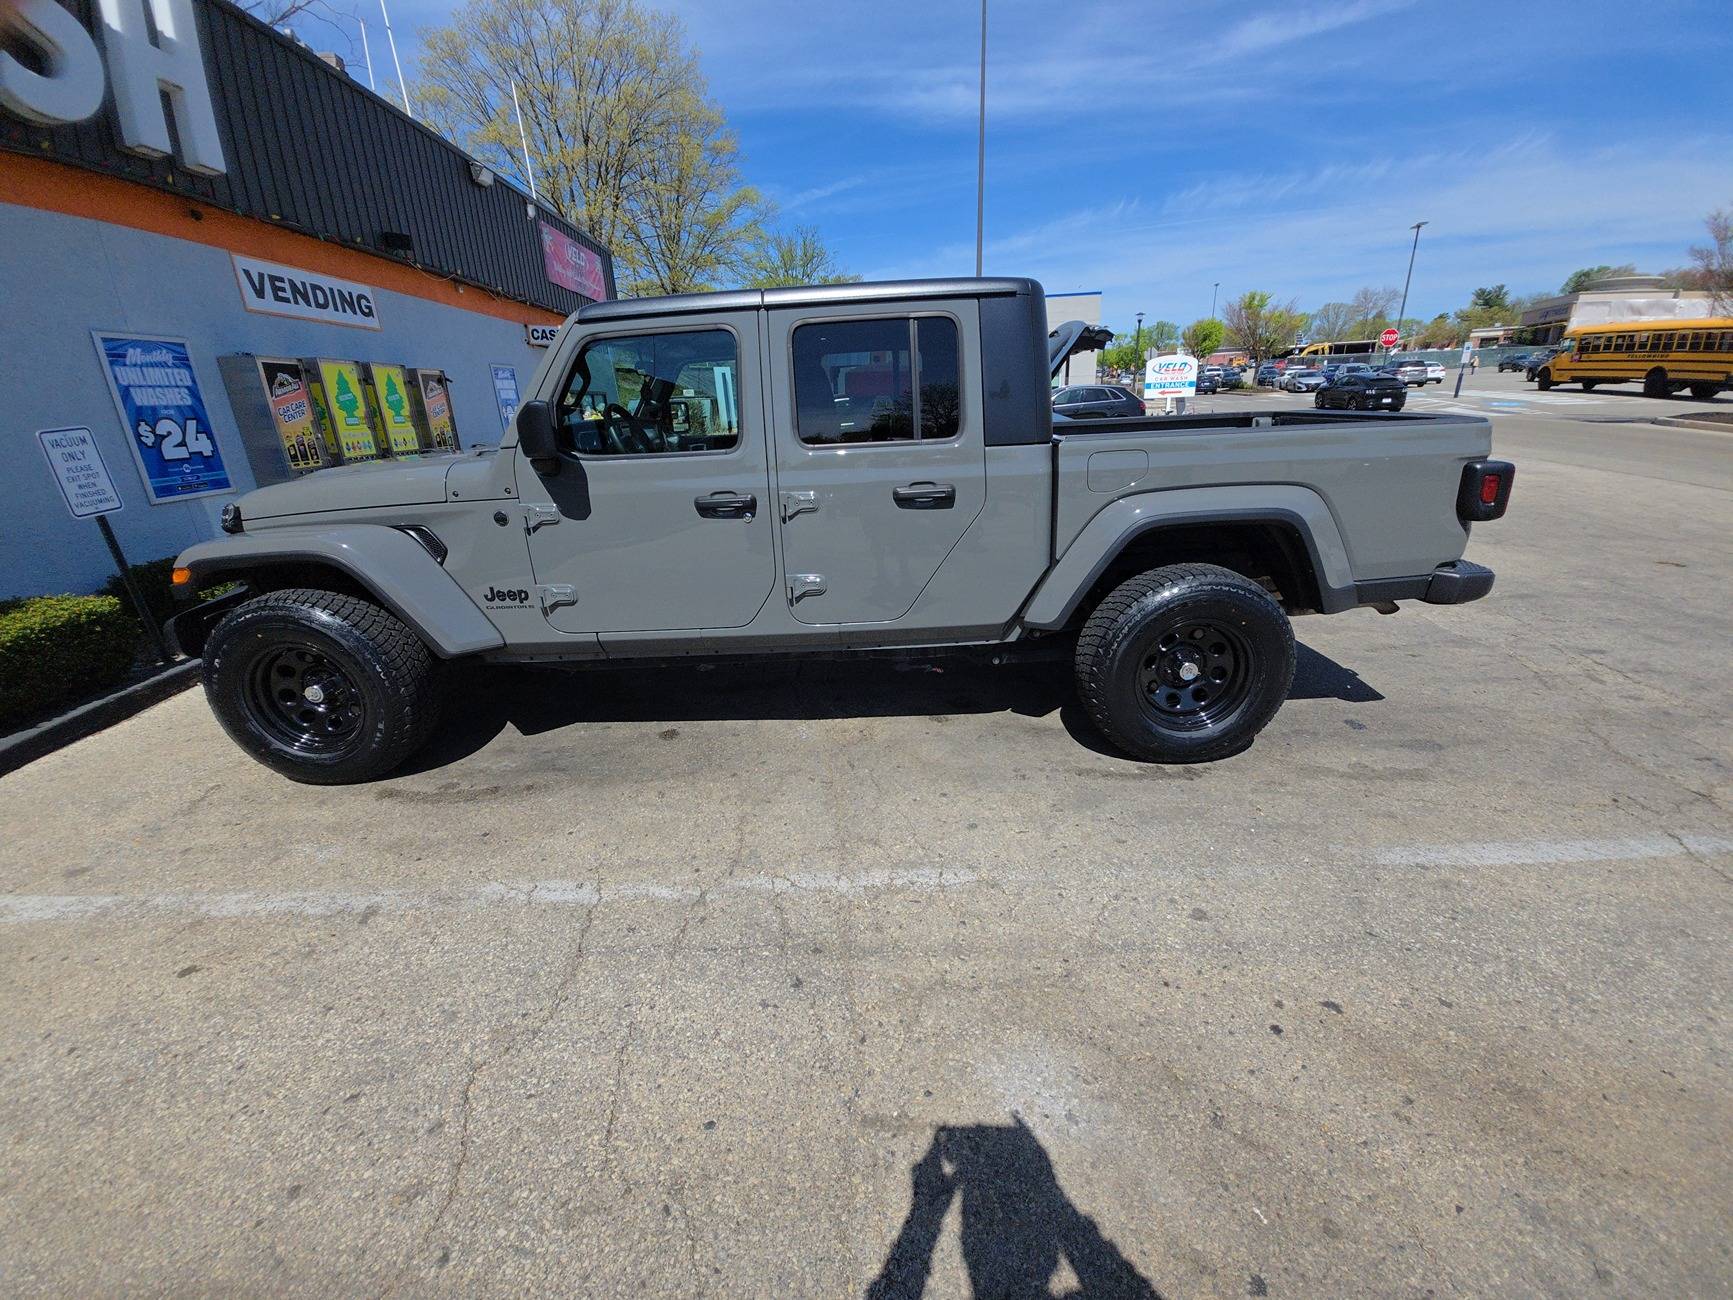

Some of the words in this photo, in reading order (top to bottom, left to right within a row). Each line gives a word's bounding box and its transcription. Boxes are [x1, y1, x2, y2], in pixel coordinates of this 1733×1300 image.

[241, 268, 375, 318] VENDING
[531, 328, 559, 341] CAS
[1381, 333, 1398, 341] STOP
[126, 348, 174, 366] Monthly
[114, 365, 193, 386] UNLIMITED
[1150, 381, 1188, 389] ENTRANCE
[128, 386, 193, 406] WASHES
[278, 405, 291, 416] CAR
[291, 400, 306, 411] CARE
[284, 409, 306, 423] CENTER
[48, 435, 88, 449] VACUUM
[61, 450, 86, 462] ONLY
[66, 464, 94, 474] PLEASE
[66, 474, 80, 483] EXIT
[83, 472, 99, 481] SPOT
[78, 481, 97, 490] WHEN
[75, 489, 106, 499] FINISHED
[74, 496, 114, 508] VACUUMING
[483, 586, 529, 604] Jeep
